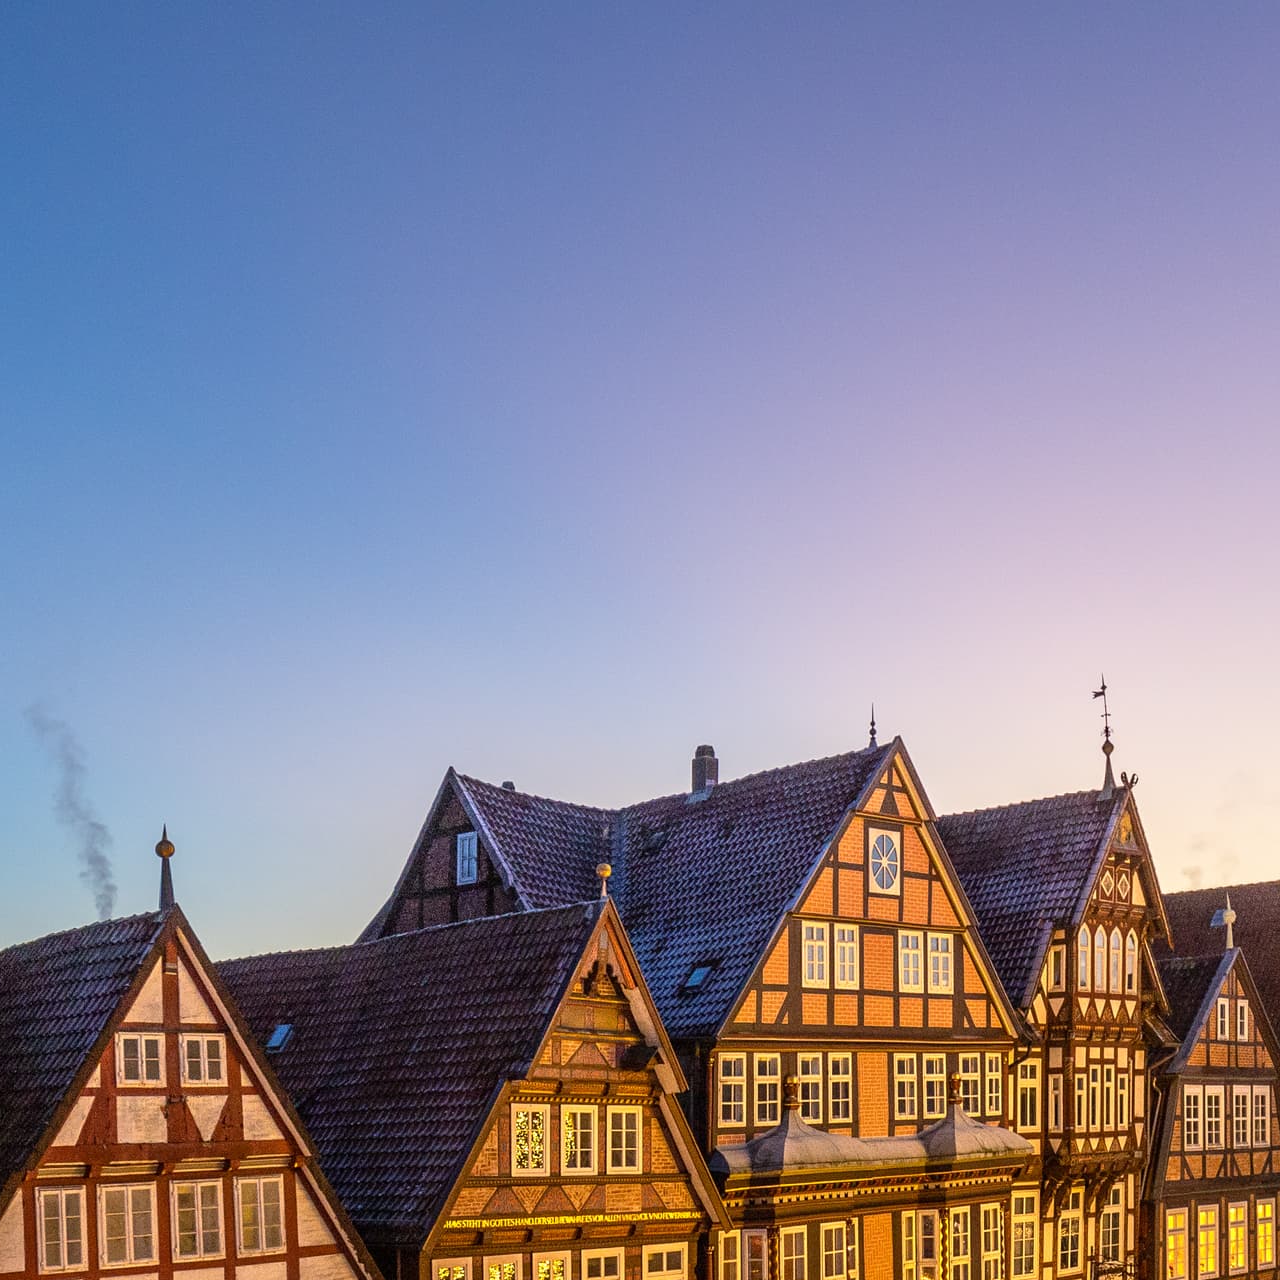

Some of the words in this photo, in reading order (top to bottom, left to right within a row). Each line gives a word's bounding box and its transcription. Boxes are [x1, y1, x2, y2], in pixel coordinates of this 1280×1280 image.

[461, 1218, 480, 1228] STEHT
[481, 1218, 490, 1228] IN
[490, 1217, 517, 1228] GOTTES
